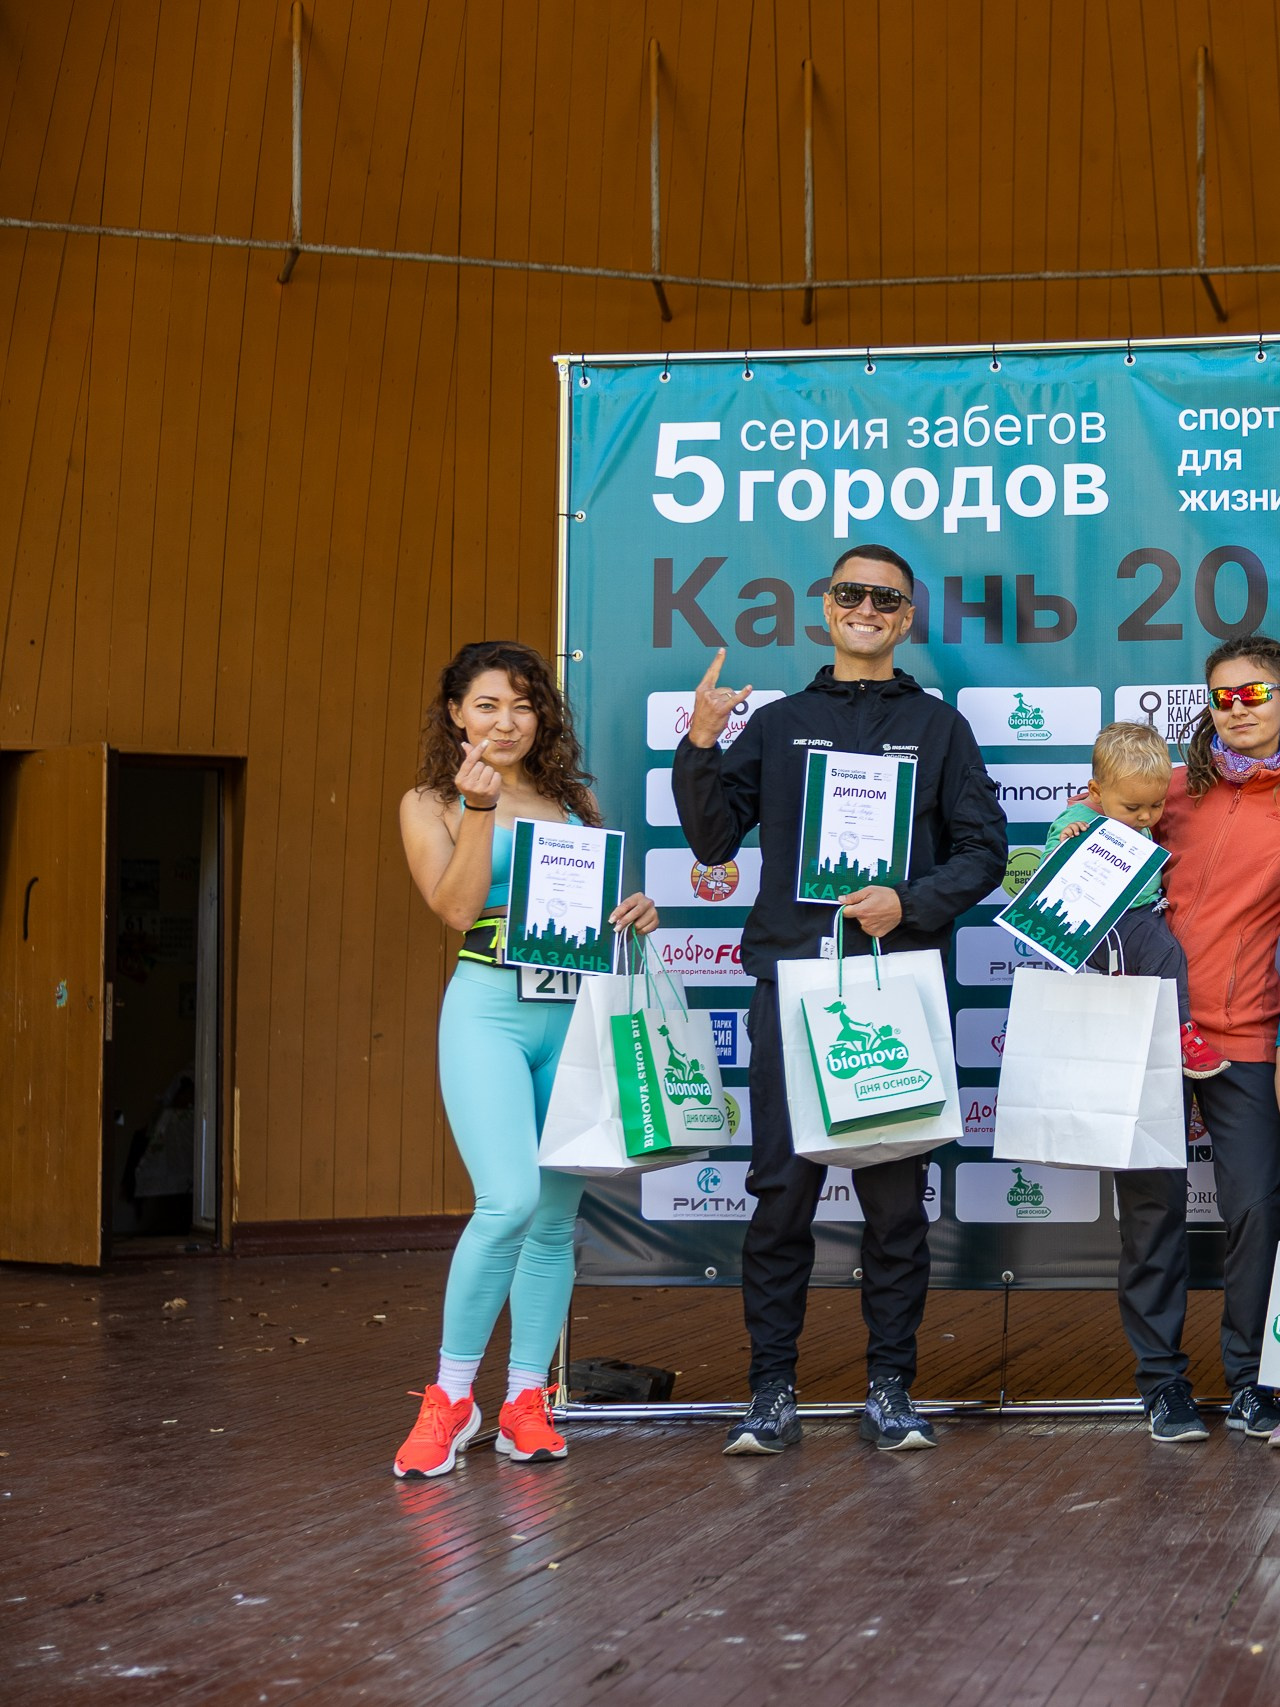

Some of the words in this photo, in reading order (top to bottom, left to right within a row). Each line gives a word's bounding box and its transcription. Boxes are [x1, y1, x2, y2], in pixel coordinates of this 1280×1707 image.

[1178, 406, 1280, 437] спорт
[740, 416, 889, 460] серия
[906, 404, 1108, 448] забегов
[1177, 448, 1243, 477] для
[652, 421, 726, 525] 5
[738, 462, 1110, 539] городов
[1008, 716, 1044, 726] bionova
[1167, 706, 1192, 723] КАК
[793, 738, 807, 746] DIE
[808, 739, 834, 748] HARD
[831, 768, 838, 777] 5
[837, 772, 867, 780] городов
[833, 786, 887, 800] ДИПЛОМ
[1098, 828, 1106, 836] 5
[538, 837, 545, 846] 5
[544, 841, 575, 850] городов
[540, 854, 596, 870] ДИПЛОМ
[1087, 842, 1132, 874] ДИПЛОМ
[1004, 909, 1080, 966] КАЗАНЬ
[511, 946, 611, 972] КАЗАНЬ
[825, 1044, 909, 1072] bionova
[663, 1076, 713, 1097] bionova
[859, 1083, 882, 1096] ДНЯ
[882, 1074, 925, 1091] ОСНОВА
[686, 1113, 699, 1123] ДНЯ
[699, 1113, 722, 1123] ОСНОВА
[672, 1197, 746, 1212] РИТМ
[1007, 1192, 1044, 1203] bionova
